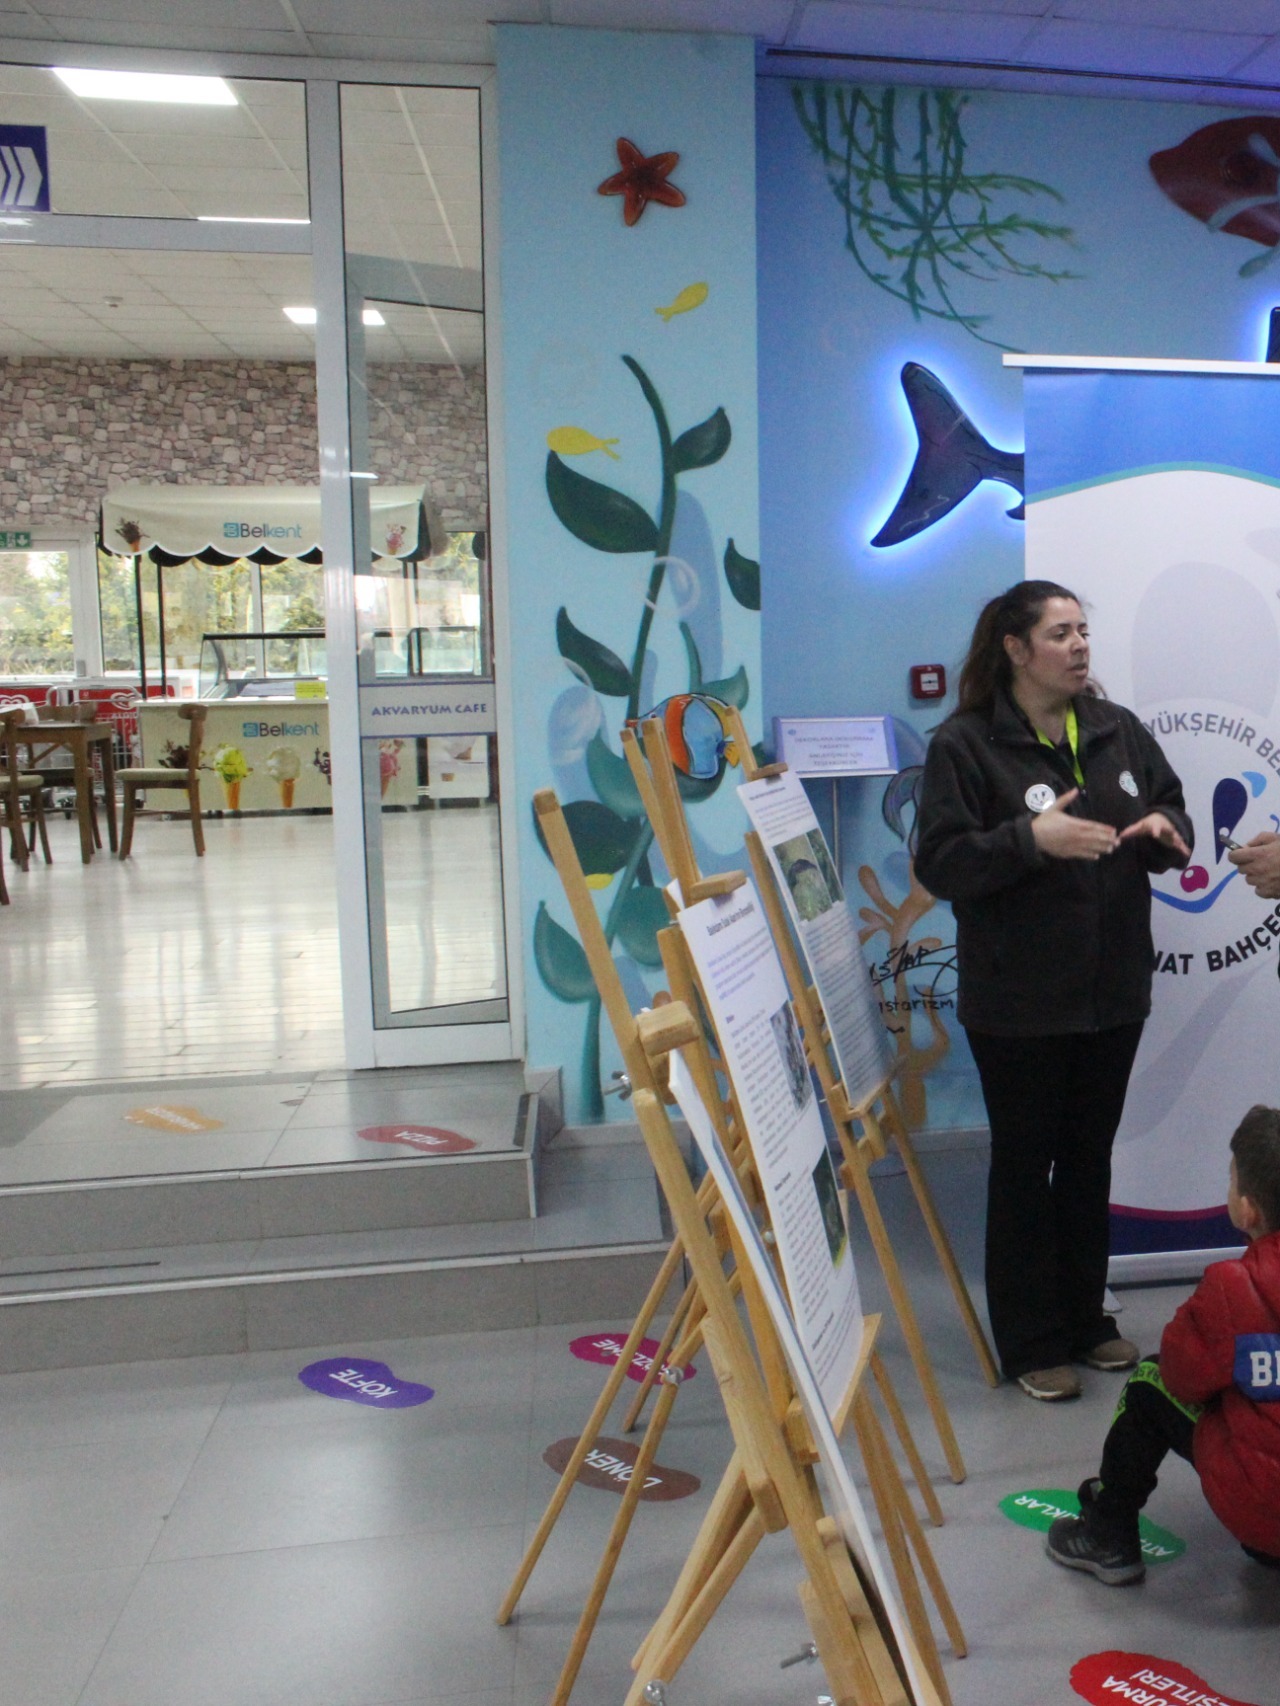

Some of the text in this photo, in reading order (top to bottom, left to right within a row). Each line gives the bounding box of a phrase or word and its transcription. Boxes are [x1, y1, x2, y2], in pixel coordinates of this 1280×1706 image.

[240, 523, 302, 538] Belkent
[371, 703, 487, 716] AKVARYUM CAFE
[259, 721, 319, 737] Belkent
[1143, 710, 1256, 747] YÜKŞEHİR
[328, 1368, 398, 1398] KÖFTE
